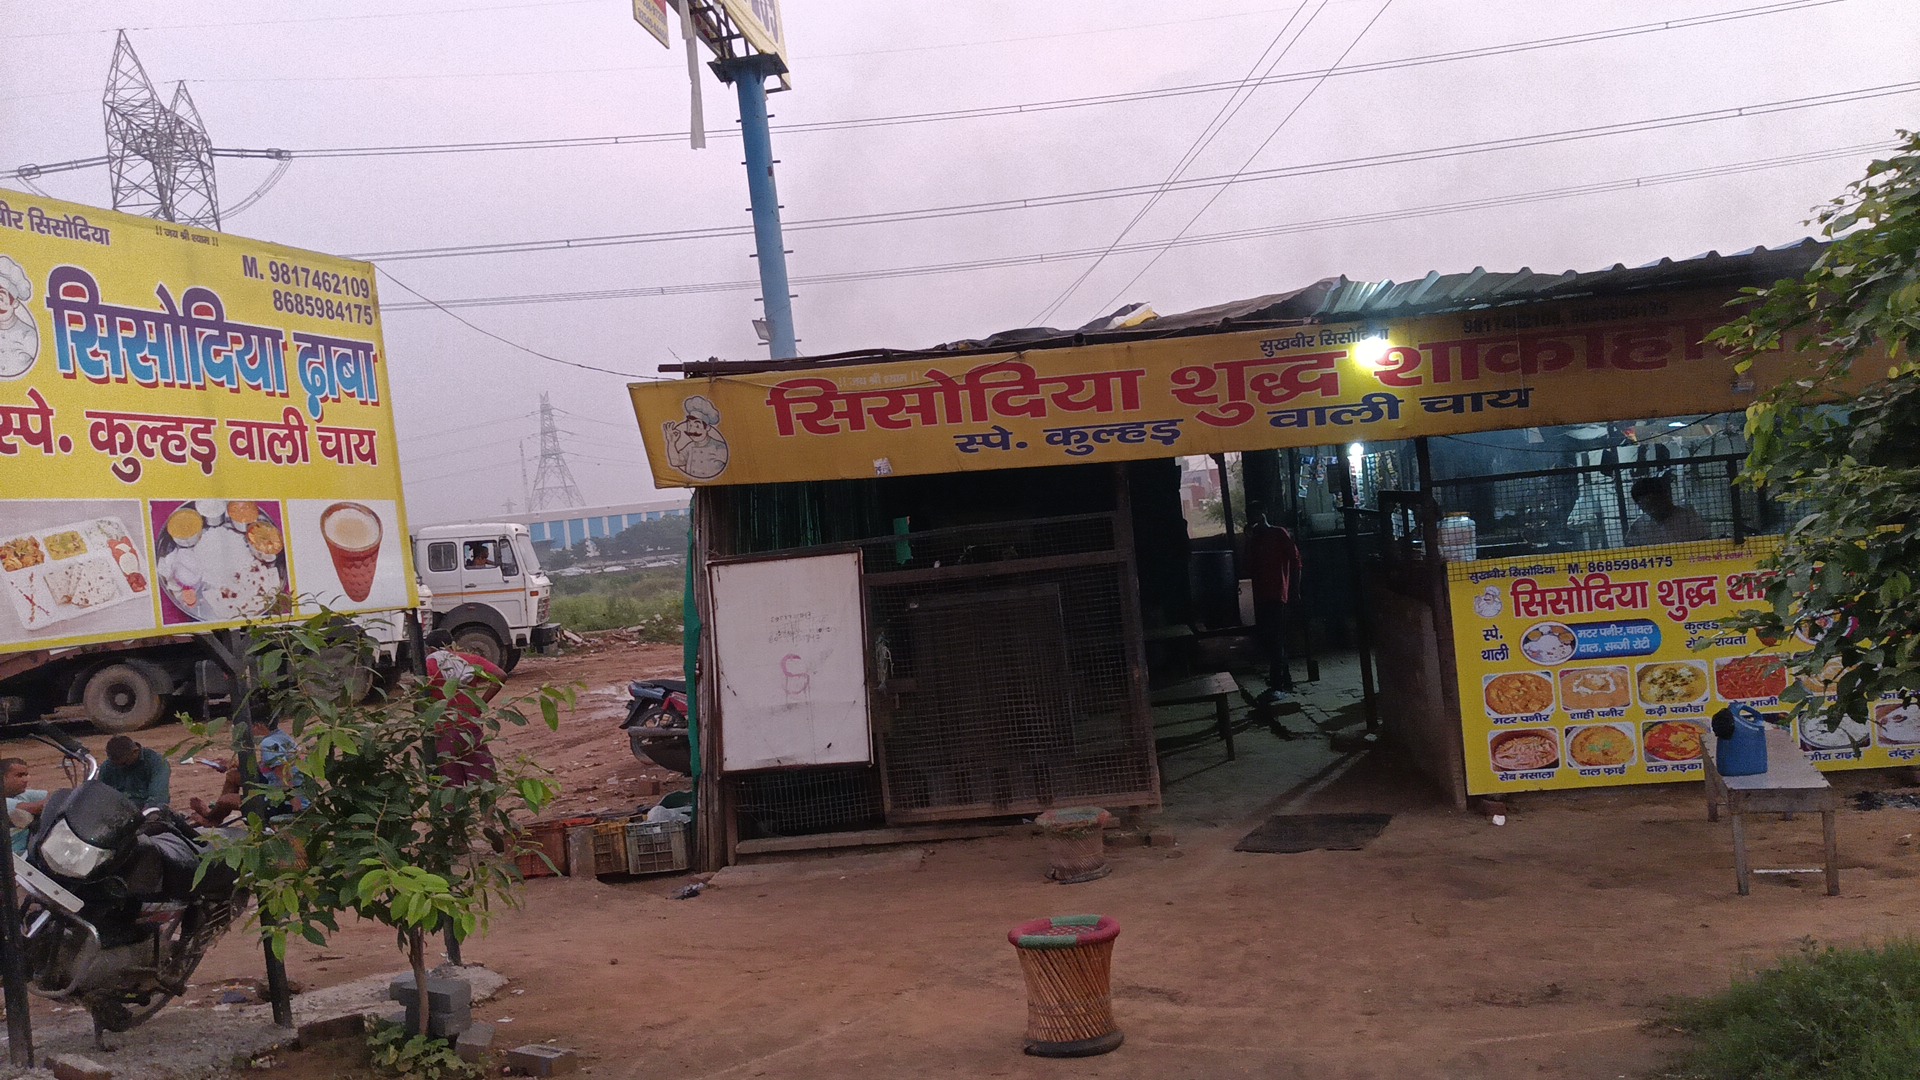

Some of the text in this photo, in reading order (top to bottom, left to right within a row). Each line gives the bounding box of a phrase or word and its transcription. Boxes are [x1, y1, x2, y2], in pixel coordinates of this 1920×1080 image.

[28, 207, 110, 246] सिसोदिया
[163, 228, 178, 239] जय
[242, 255, 370, 299] M. 9817462109
[273, 290, 373, 326] 8685984175
[46, 264, 290, 397] सिसोदिया
[1260, 332, 1315, 358] सुखबीर
[766, 361, 1145, 437] सिसोदिया
[1170, 350, 1348, 427] शुद्ध
[953, 425, 1028, 454] स्पे.
[1267, 392, 1404, 428] वाली
[1420, 388, 1535, 414] चाय
[226, 406, 309, 465] वाली
[317, 426, 378, 466] चाय
[1567, 563, 1583, 575] M.
[1588, 556, 1673, 573] 8685984175
[1510, 573, 1648, 618] सिसोदिया
[1657, 576, 1718, 621] शुद्ध
[1483, 625, 1503, 642] स्पे.
[1577, 629, 1598, 639] मटर
[1715, 635, 1747, 647] रायता
[1481, 645, 1509, 661] थाली
[1750, 697, 1778, 707] भाजी
[1493, 714, 1550, 725] मटर पनीर
[1570, 708, 1625, 720] शाही पनीर
[1519, 771, 1555, 780] मसाला
[1579, 768, 1596, 776] दाल
[1646, 764, 1668, 773] दाल
